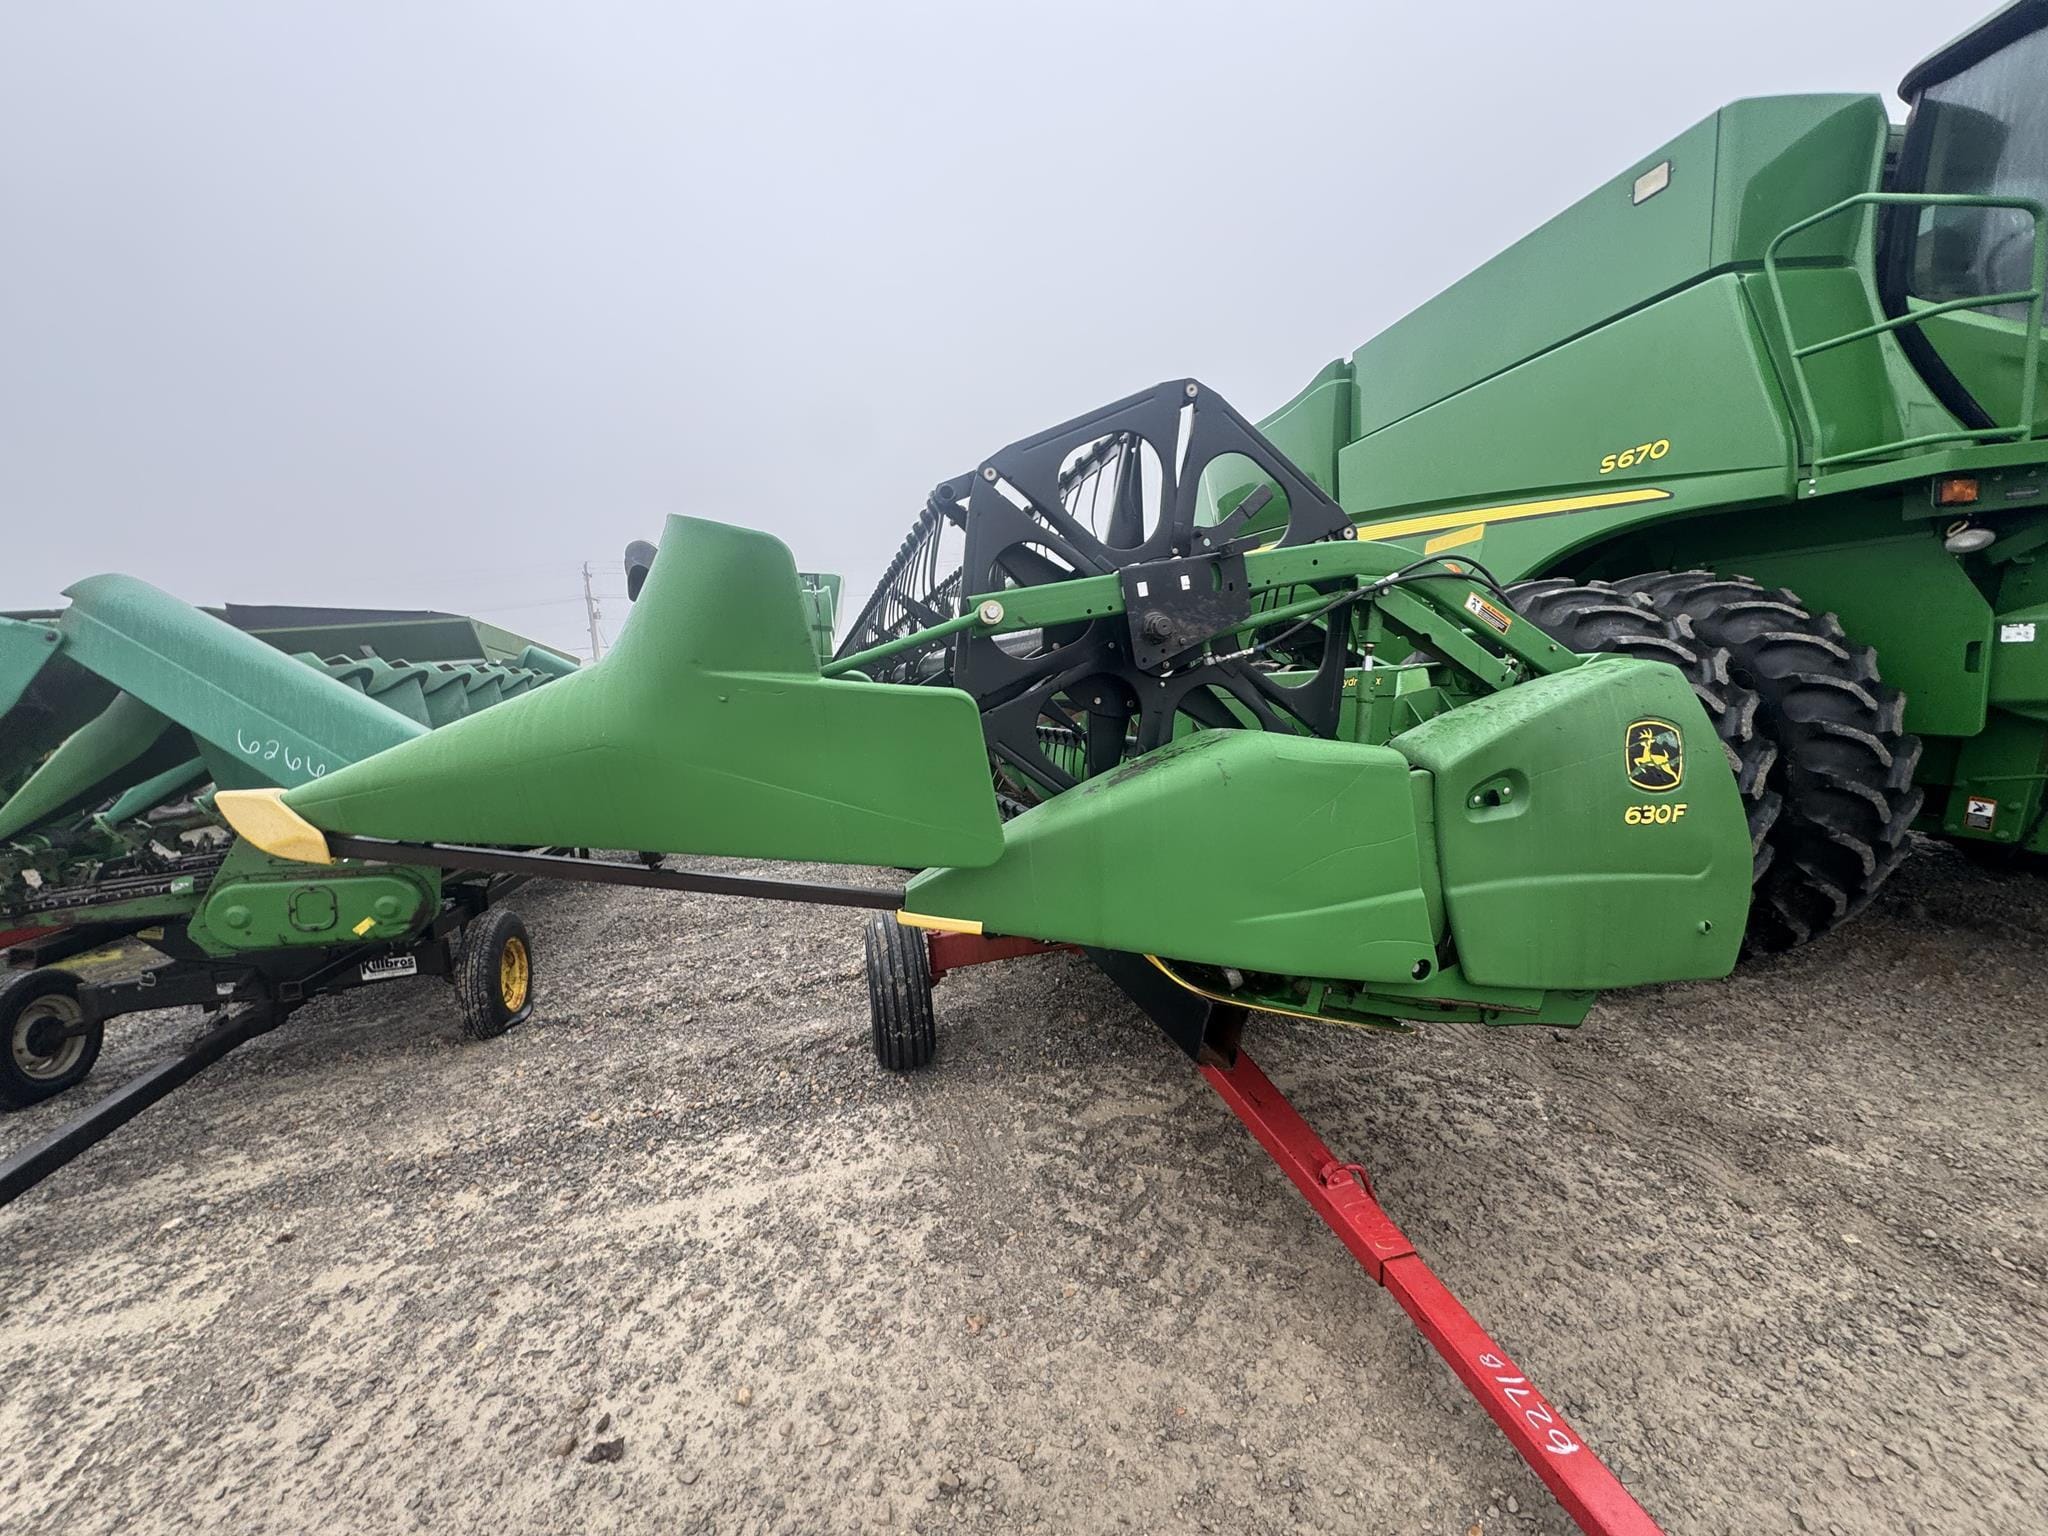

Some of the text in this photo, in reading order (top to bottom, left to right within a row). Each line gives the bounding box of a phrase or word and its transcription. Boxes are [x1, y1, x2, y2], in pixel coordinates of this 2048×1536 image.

[1599, 438, 1670, 474] S670
[237, 728, 326, 778] 6266
[1624, 803, 1688, 825] 630F
[361, 957, 415, 975] Killbros
